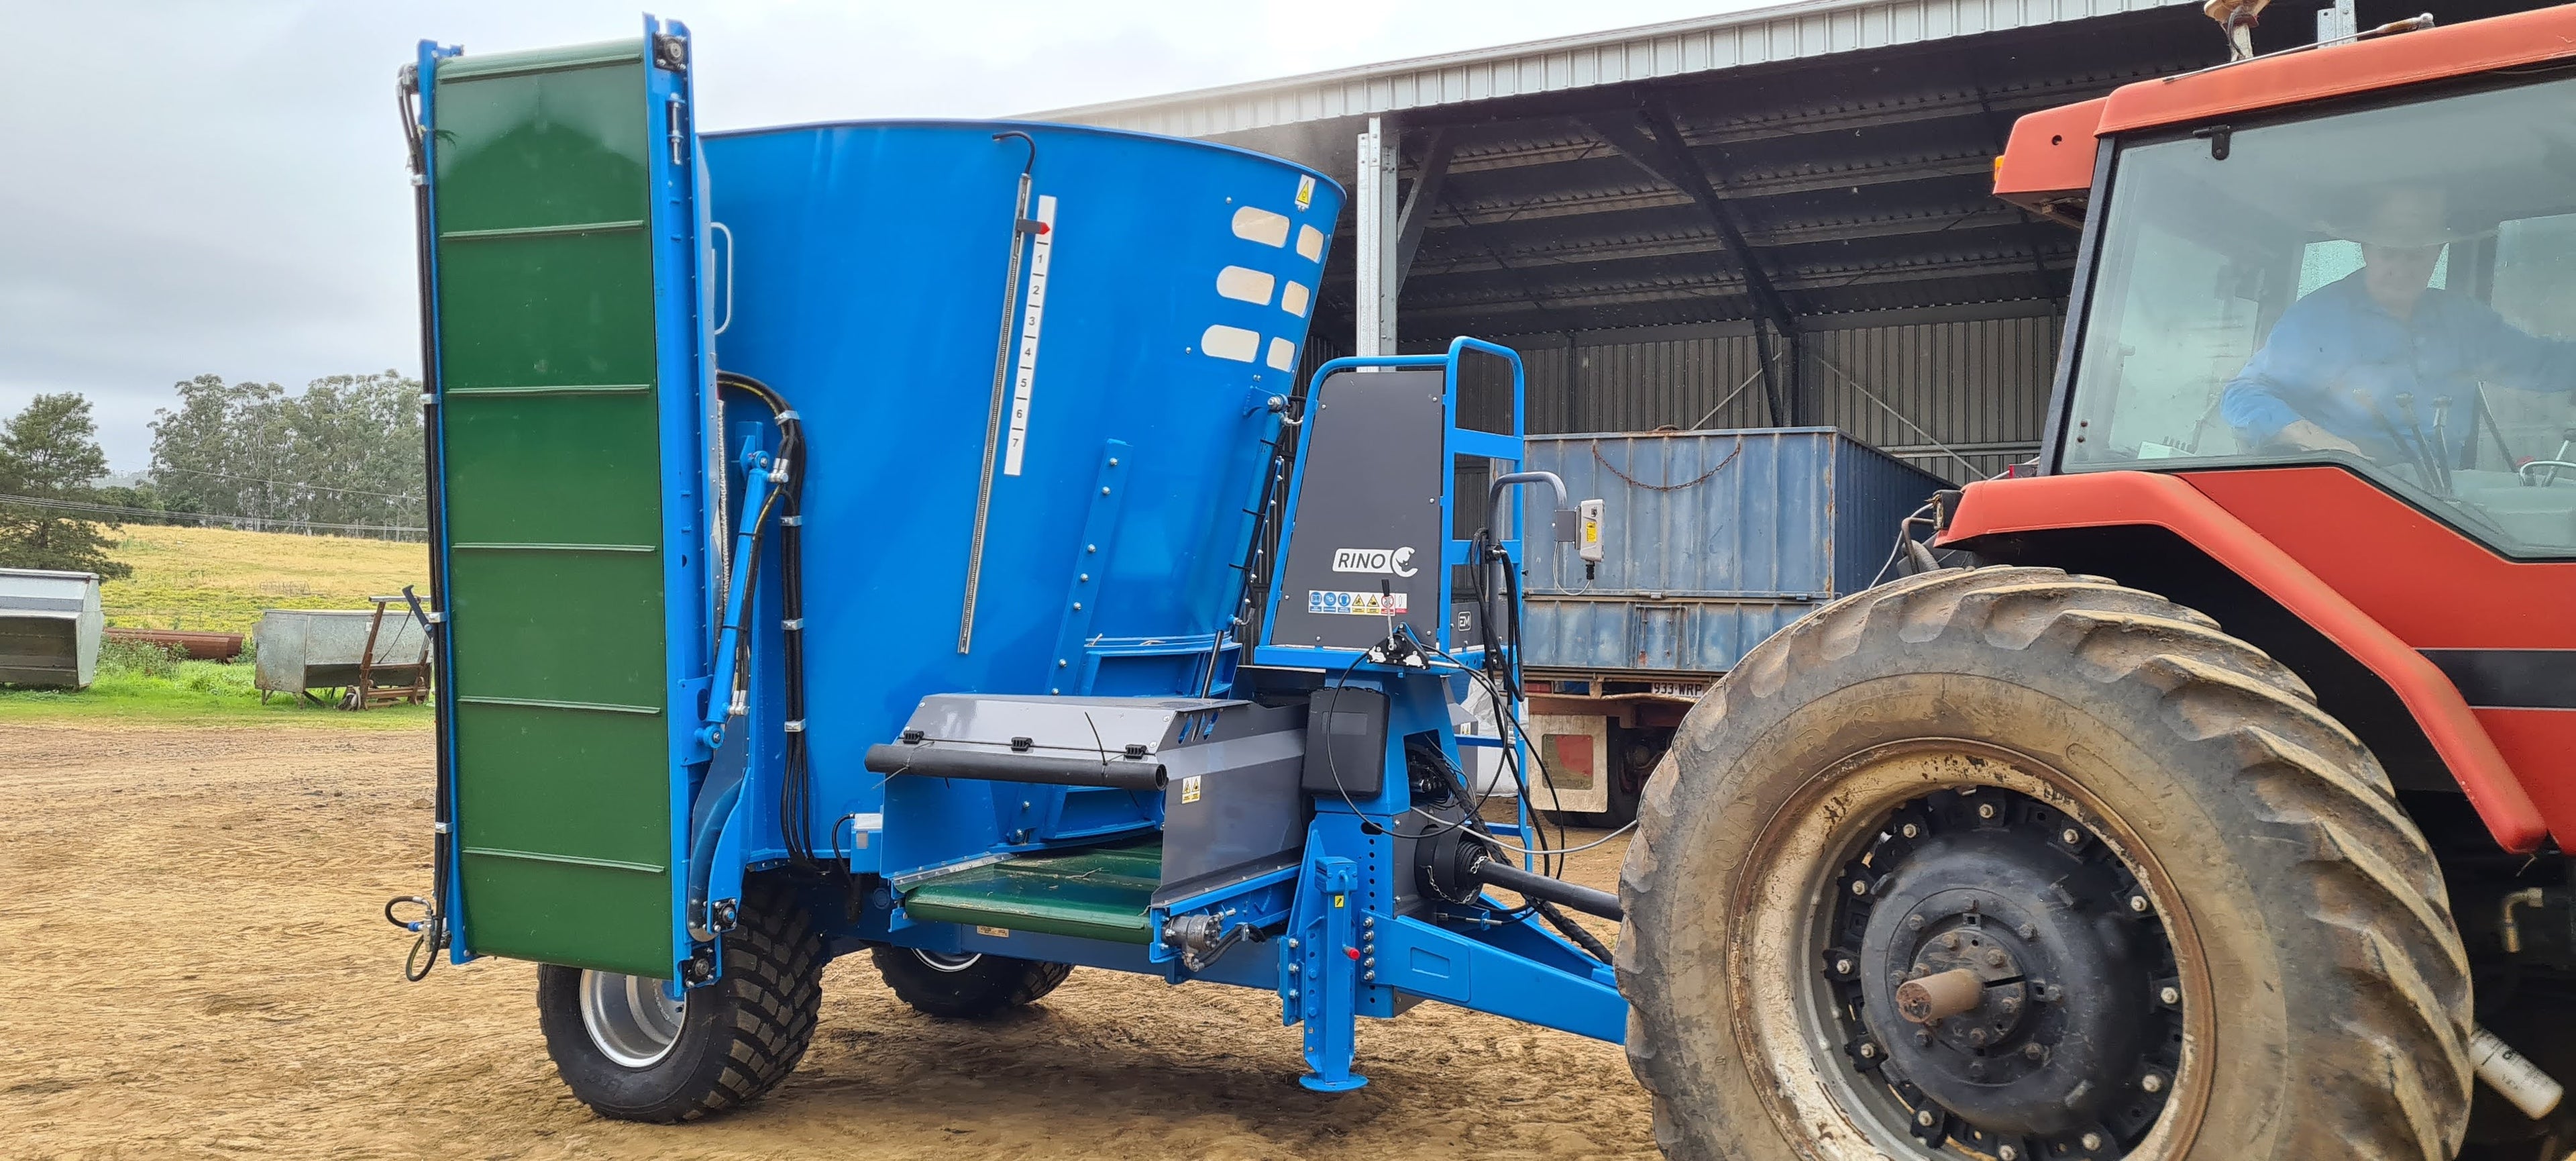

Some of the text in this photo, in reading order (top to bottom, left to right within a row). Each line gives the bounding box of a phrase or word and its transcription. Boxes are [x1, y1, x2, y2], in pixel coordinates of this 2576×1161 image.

[1038, 254, 1043, 264] 1
[1033, 285, 1040, 295] 2
[1029, 316, 1036, 326] 3
[1024, 348, 1031, 357] 4
[1020, 378, 1027, 388] 5
[1016, 409, 1023, 419] 6
[1012, 438, 1019, 448] 7
[1338, 553, 1386, 568] RINO
